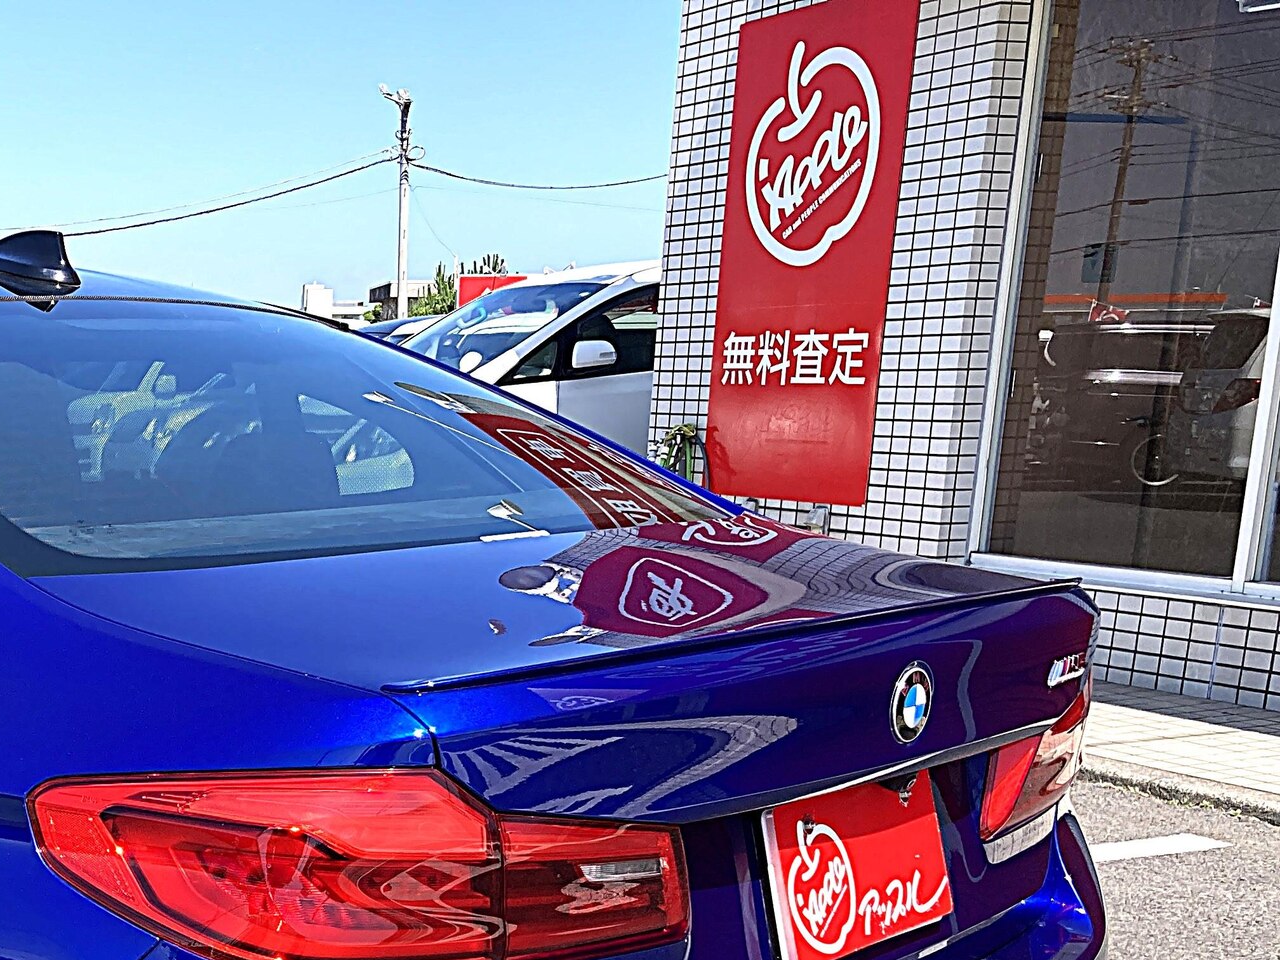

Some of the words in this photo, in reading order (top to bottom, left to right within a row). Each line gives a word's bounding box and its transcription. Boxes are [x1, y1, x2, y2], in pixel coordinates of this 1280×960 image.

[800, 199, 820, 222] PEOPLE
[721, 327, 870, 386] 無料査定
